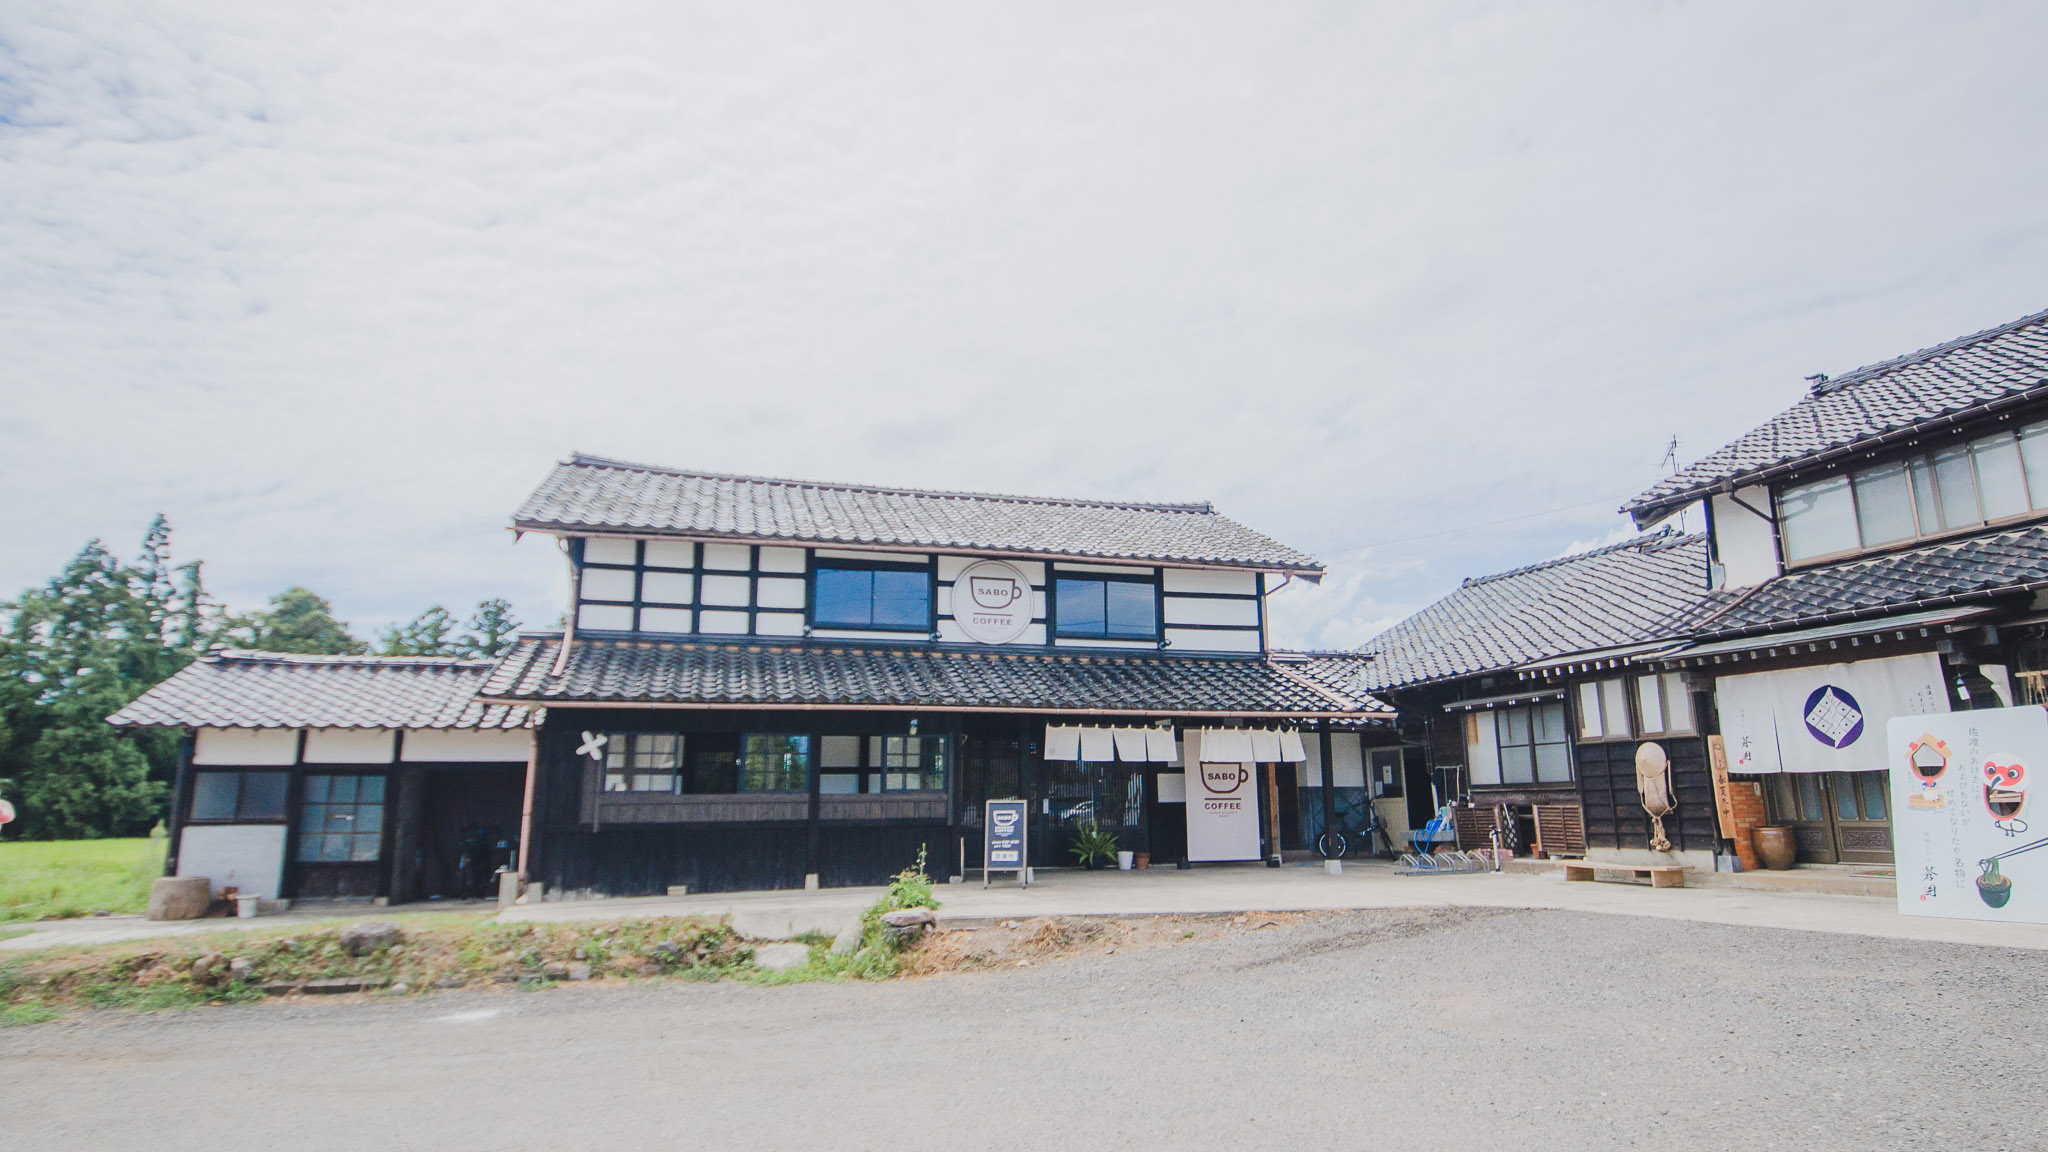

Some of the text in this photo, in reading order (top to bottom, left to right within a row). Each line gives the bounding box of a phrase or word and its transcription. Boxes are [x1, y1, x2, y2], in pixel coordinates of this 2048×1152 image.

[977, 588, 1009, 597] SABO
[972, 617, 1013, 626] COFFEE
[1207, 772, 1236, 781] SABO
[1204, 802, 1242, 810] COFFEE
